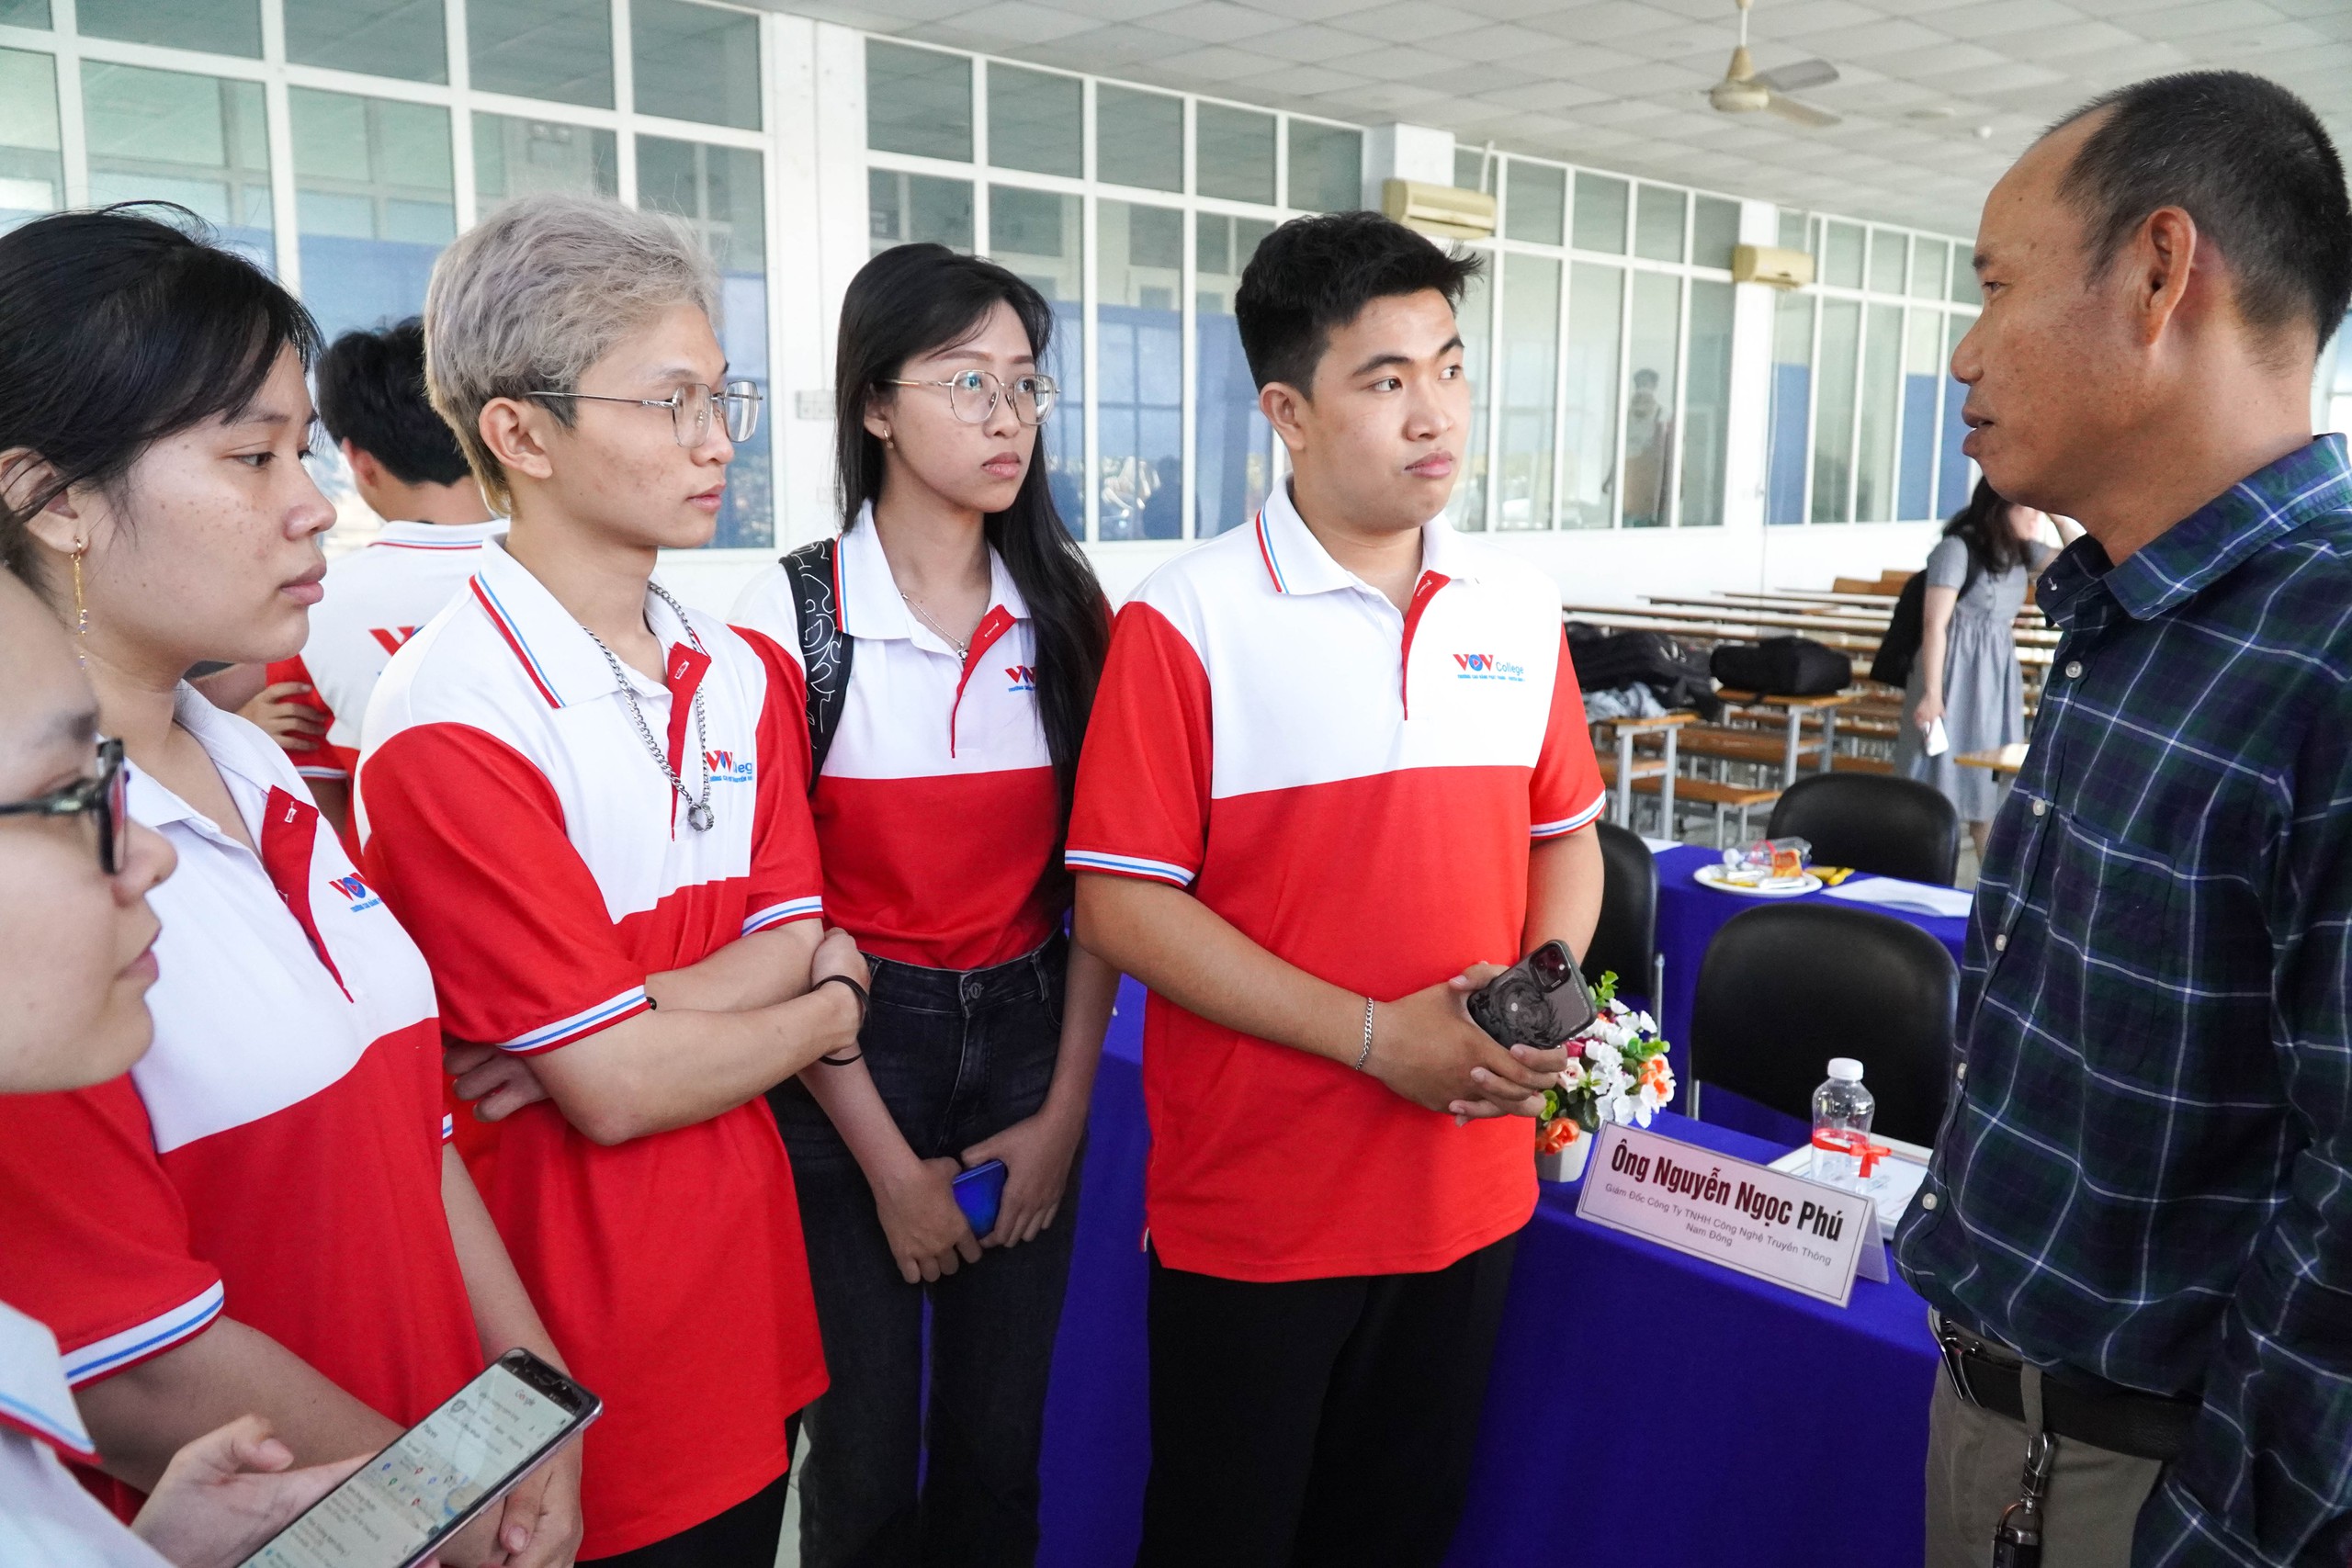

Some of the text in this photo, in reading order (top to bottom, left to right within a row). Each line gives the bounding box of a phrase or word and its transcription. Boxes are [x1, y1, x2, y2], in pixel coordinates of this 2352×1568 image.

[1453, 654, 1524, 676] VOV College
[1611, 1137, 1843, 1241] Ông Nguyễn Ngọc Phú
[1605, 1182, 1626, 1196] Giám
[1646, 1197, 1669, 1213] Công
[1672, 1203, 1682, 1216] Ty
[1685, 1208, 1712, 1224] TNHH
[1713, 1218, 1736, 1235] Công
[1738, 1226, 1763, 1243] Nghệ
[1802, 1246, 1831, 1266] Thông
[1685, 1222, 1706, 1235] Nam
